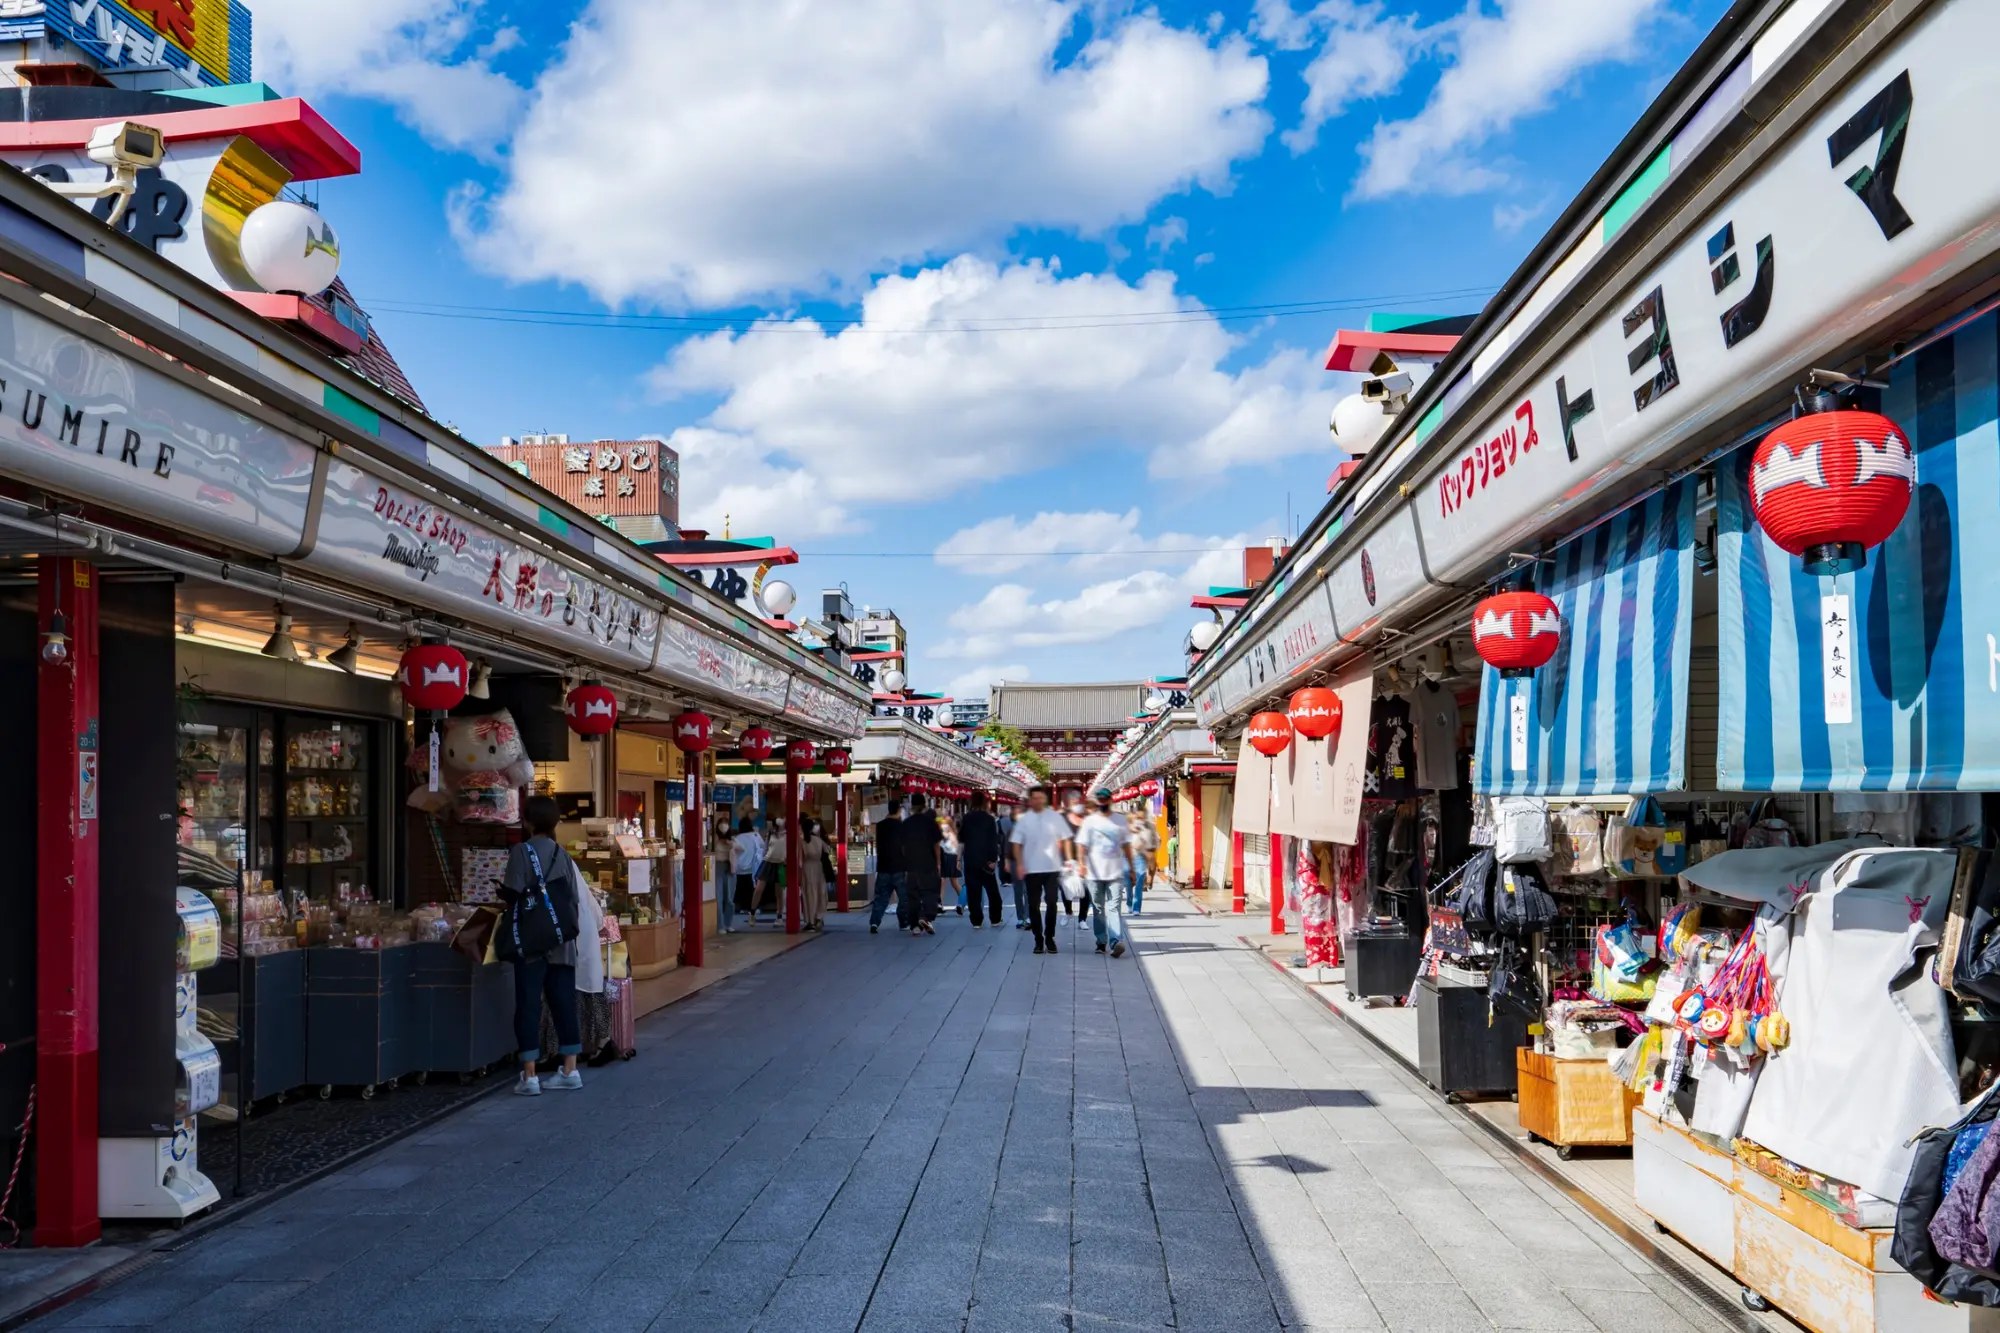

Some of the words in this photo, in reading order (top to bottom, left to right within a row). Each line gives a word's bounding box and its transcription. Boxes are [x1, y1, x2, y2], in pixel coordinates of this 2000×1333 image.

[1556, 68, 1914, 463] トヨシマ
[1439, 399, 1539, 519] バックショップ
